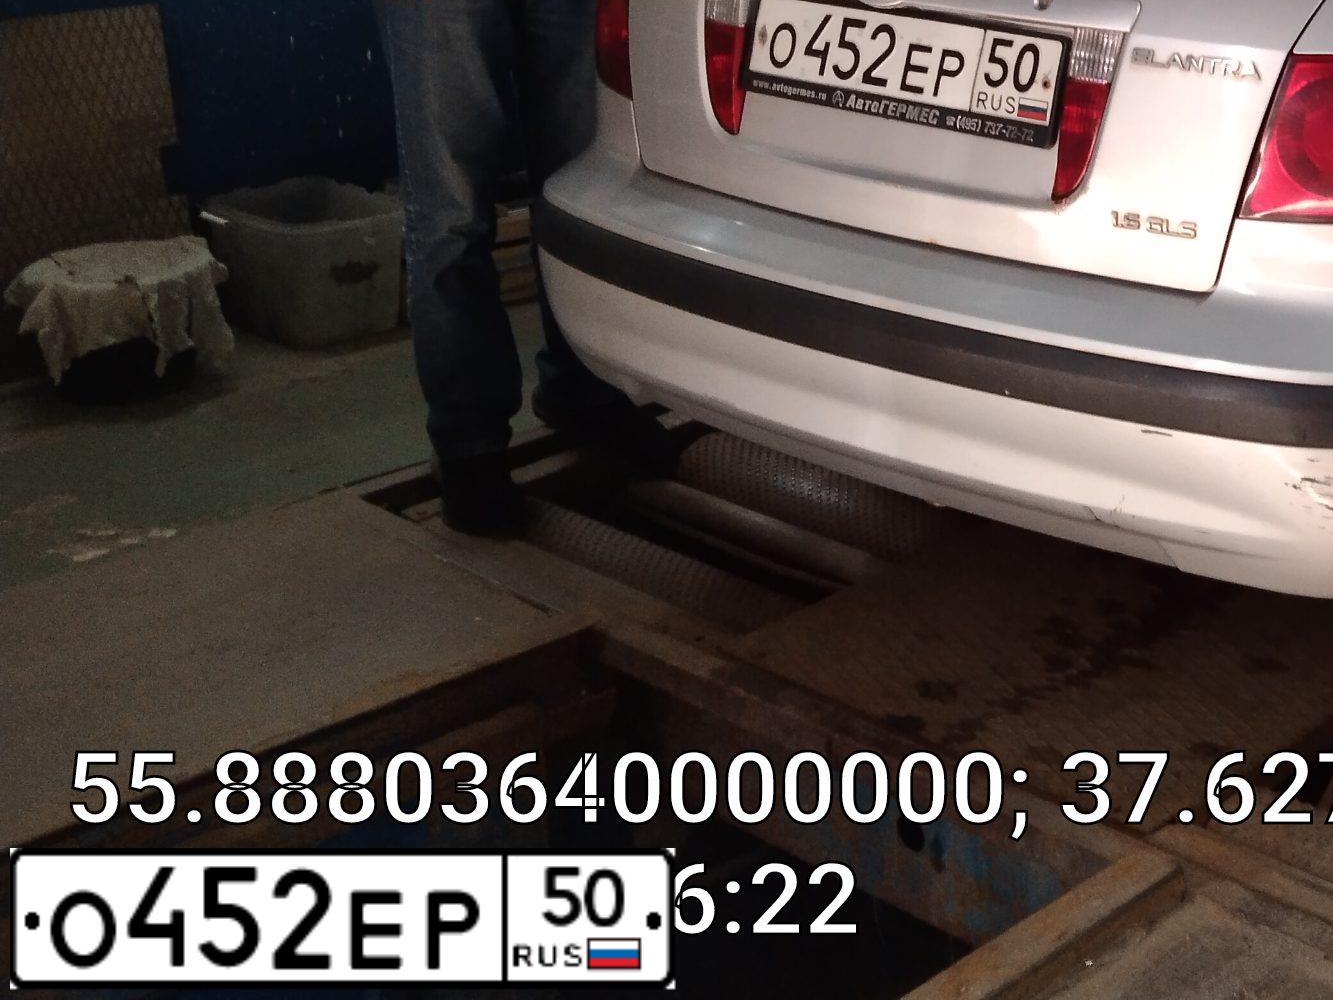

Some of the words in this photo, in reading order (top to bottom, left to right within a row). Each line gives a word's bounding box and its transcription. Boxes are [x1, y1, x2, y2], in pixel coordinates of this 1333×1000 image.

[983, 37, 1041, 93] 50
[1130, 46, 1263, 82] ELANTRA
[752, 78, 828, 102] www.avtogermes.ru
[976, 91, 1017, 115] RUS
[956, 114, 982, 133] (495)
[1146, 215, 1198, 240] GLS
